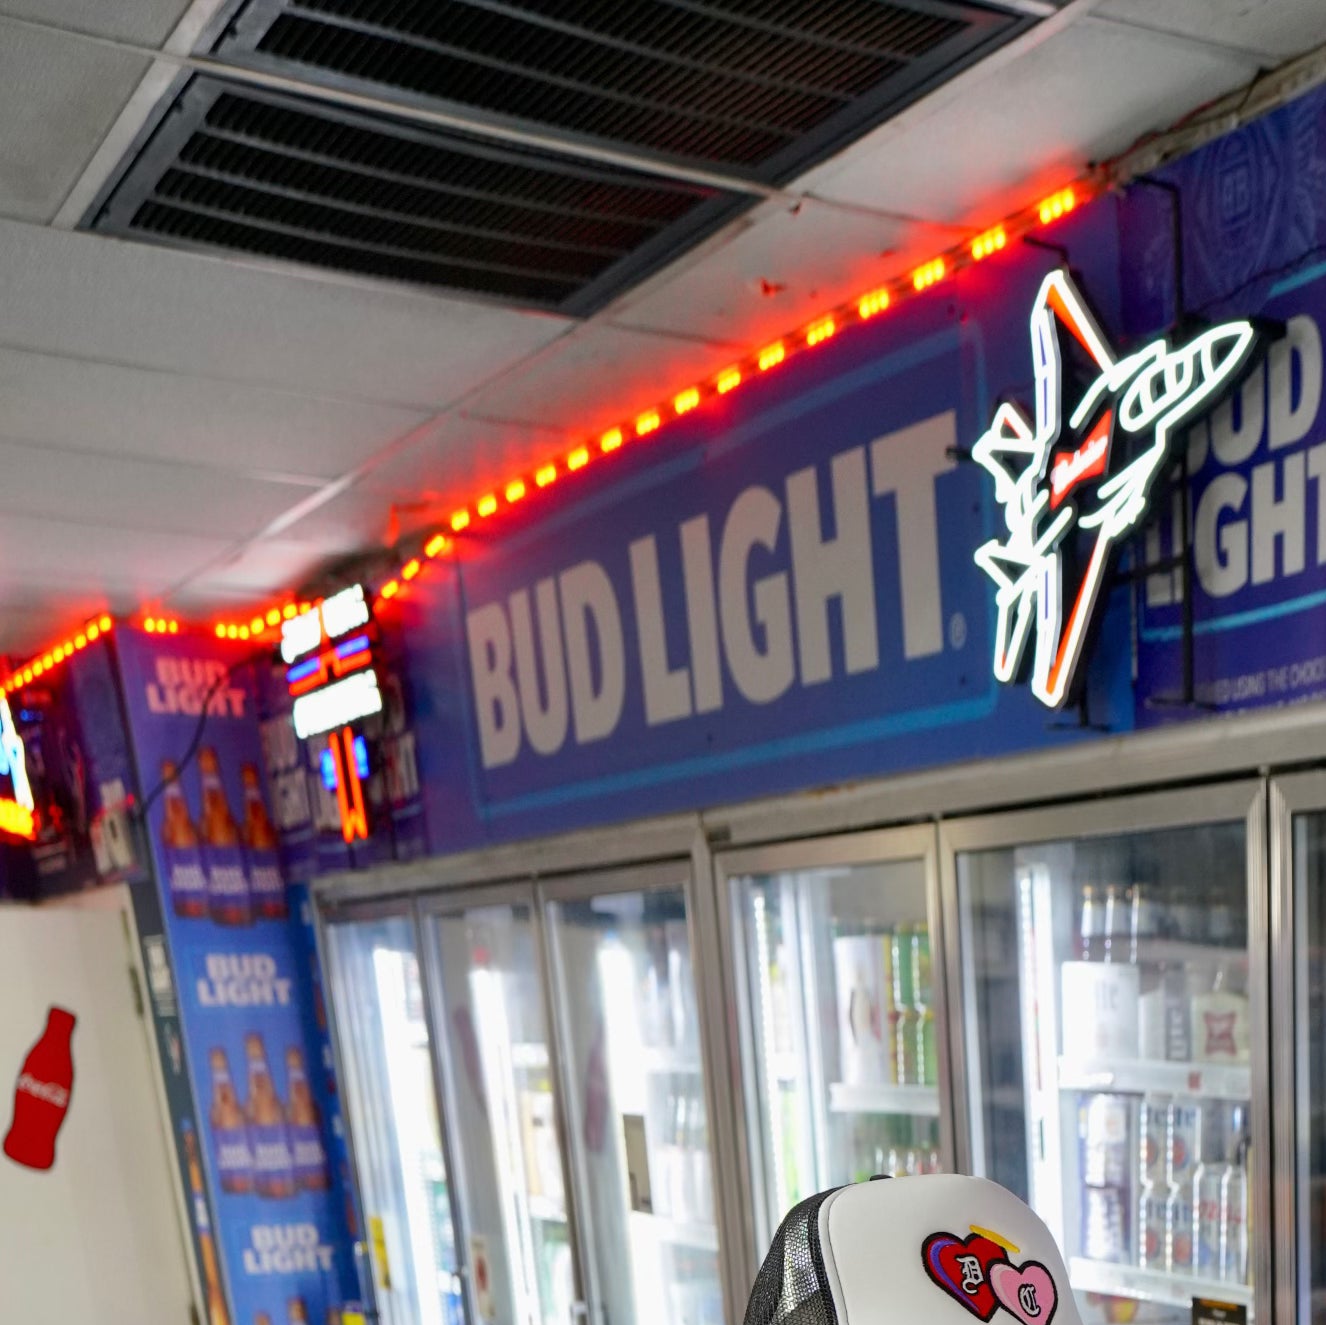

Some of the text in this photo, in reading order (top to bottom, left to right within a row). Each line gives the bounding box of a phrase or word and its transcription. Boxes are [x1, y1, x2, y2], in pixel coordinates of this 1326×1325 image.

[466, 559, 625, 769] BUD
[629, 409, 957, 726] LIGHT
[206, 953, 277, 981] BUD
[196, 976, 291, 1007] LIGHT
[251, 1223, 318, 1252] BUD
[244, 1244, 335, 1275] LIGHT
